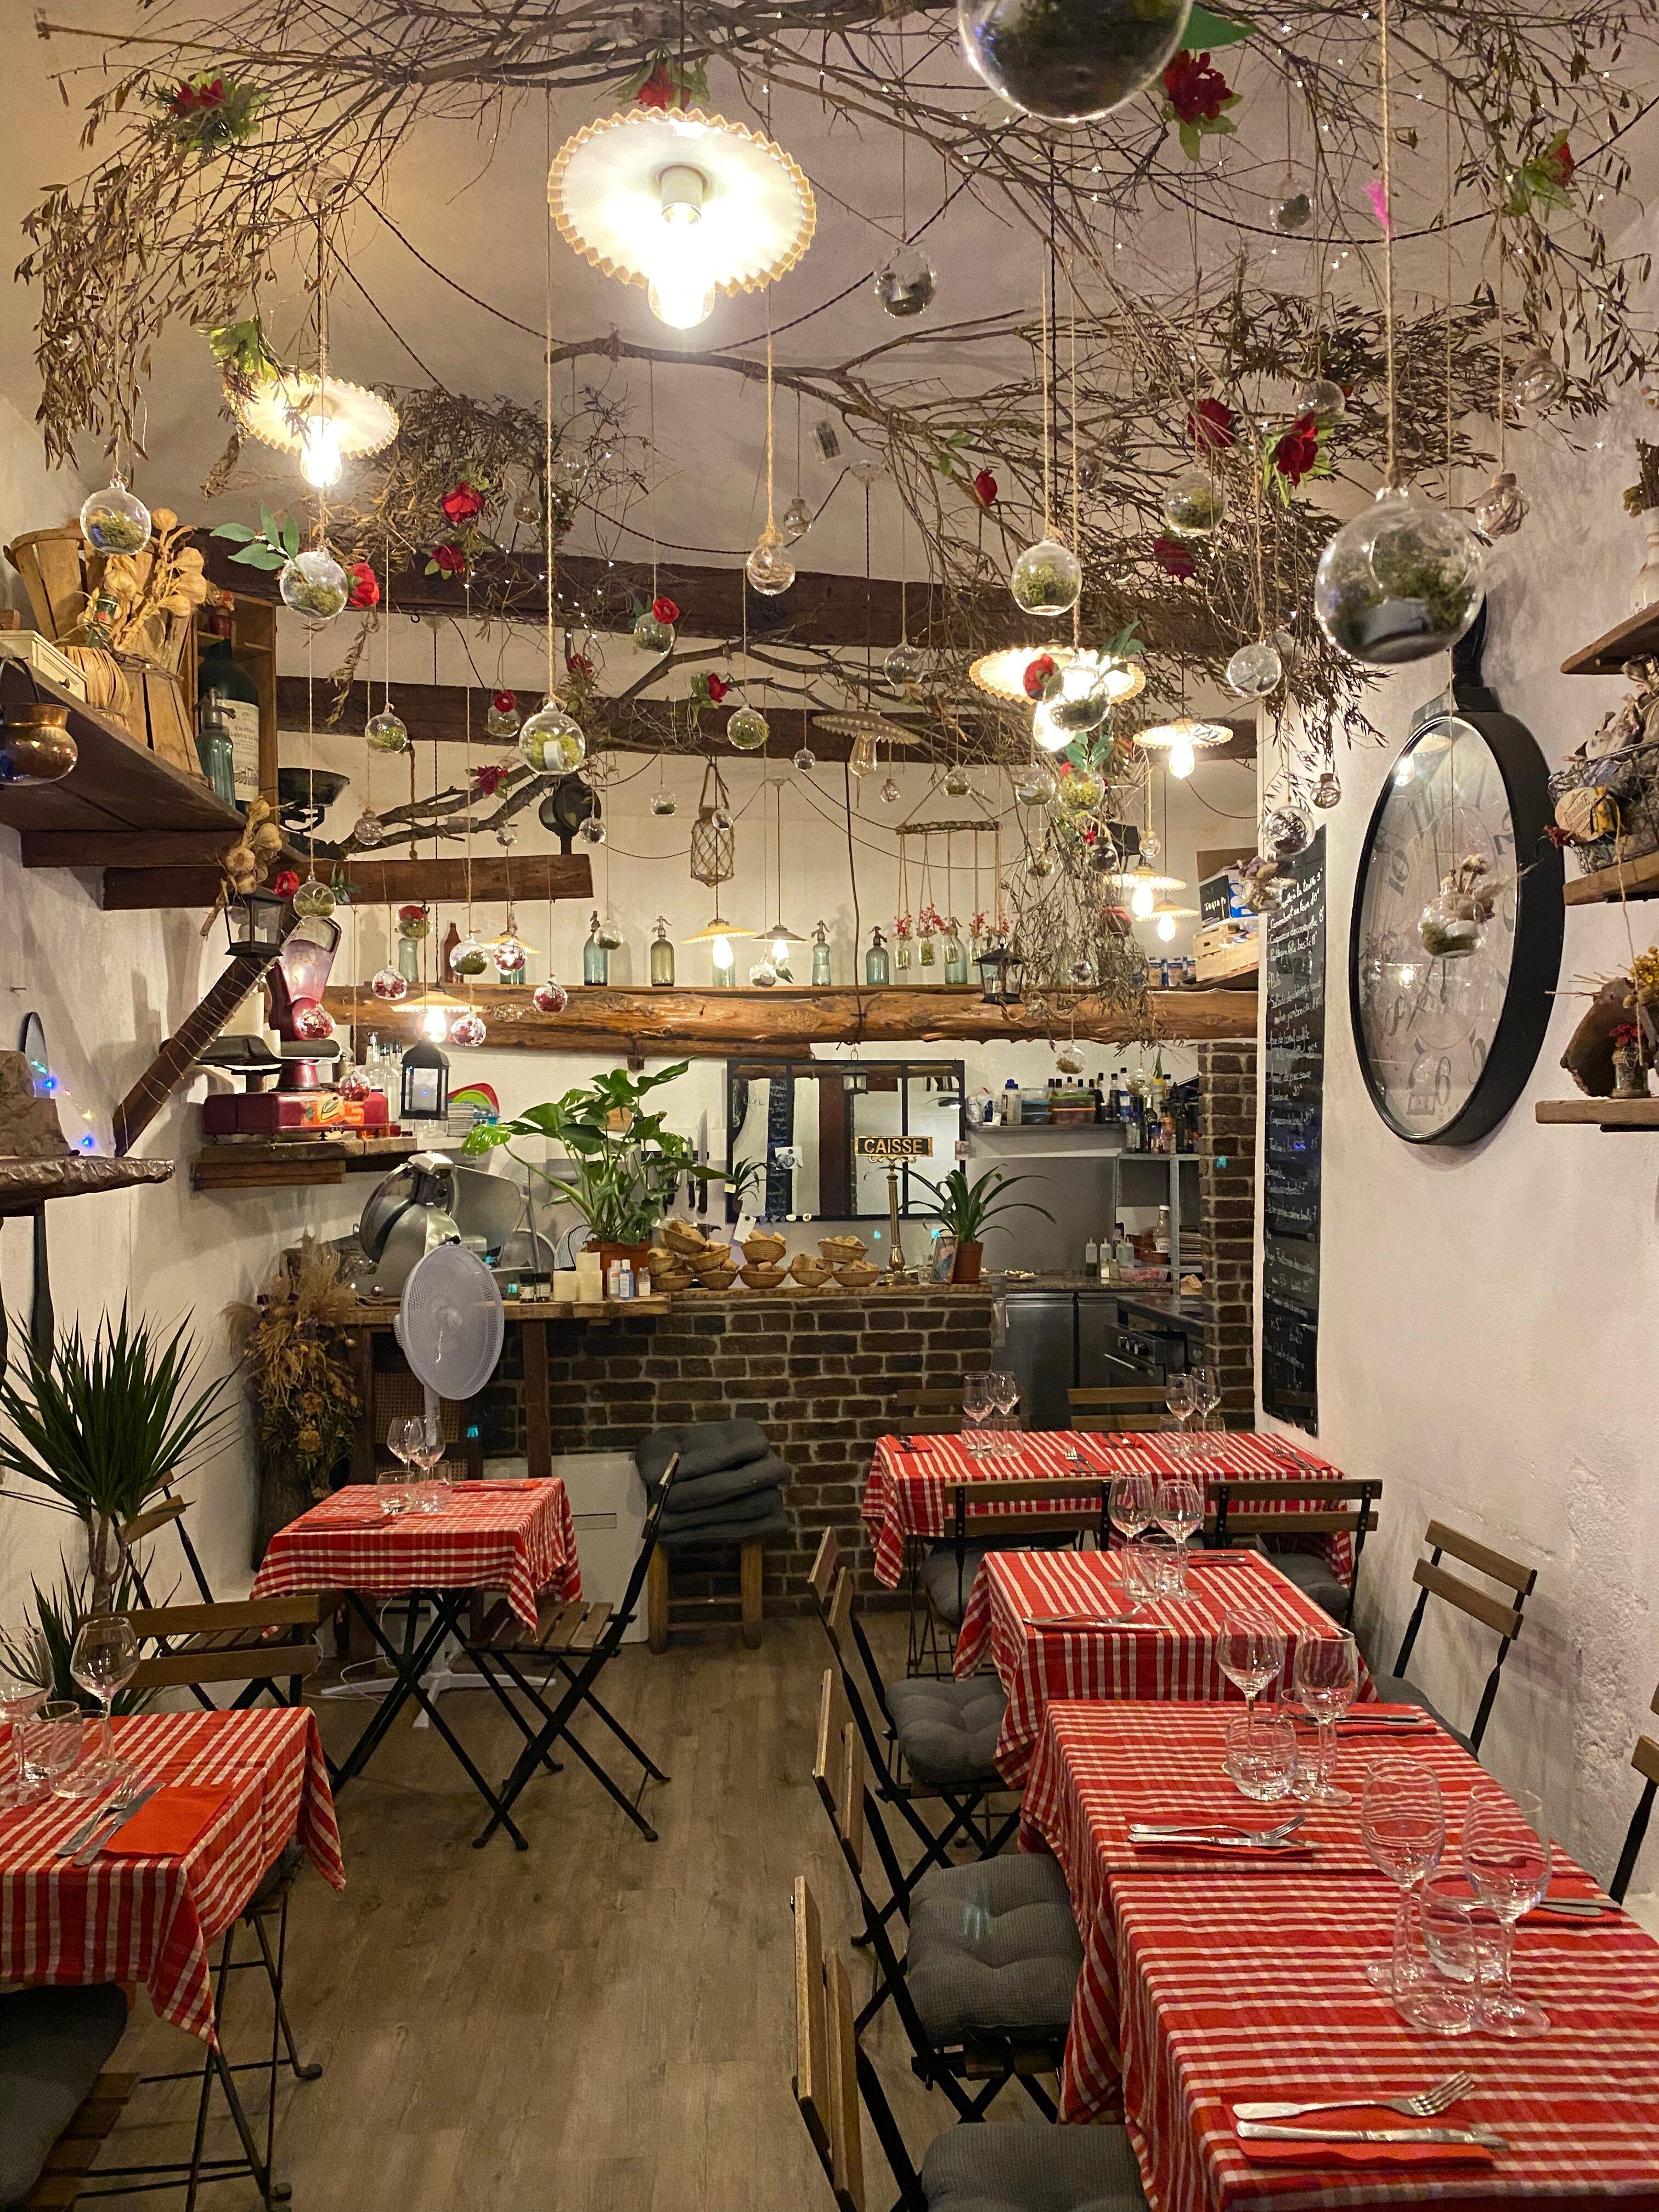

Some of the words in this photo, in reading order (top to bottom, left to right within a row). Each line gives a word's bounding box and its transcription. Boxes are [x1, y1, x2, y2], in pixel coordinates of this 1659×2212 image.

[1387, 849, 1410, 902] 10
[1435, 1056, 1452, 1106] 6
[1467, 1026, 1487, 1085] 5
[864, 1138, 923, 1154] CAISSE
